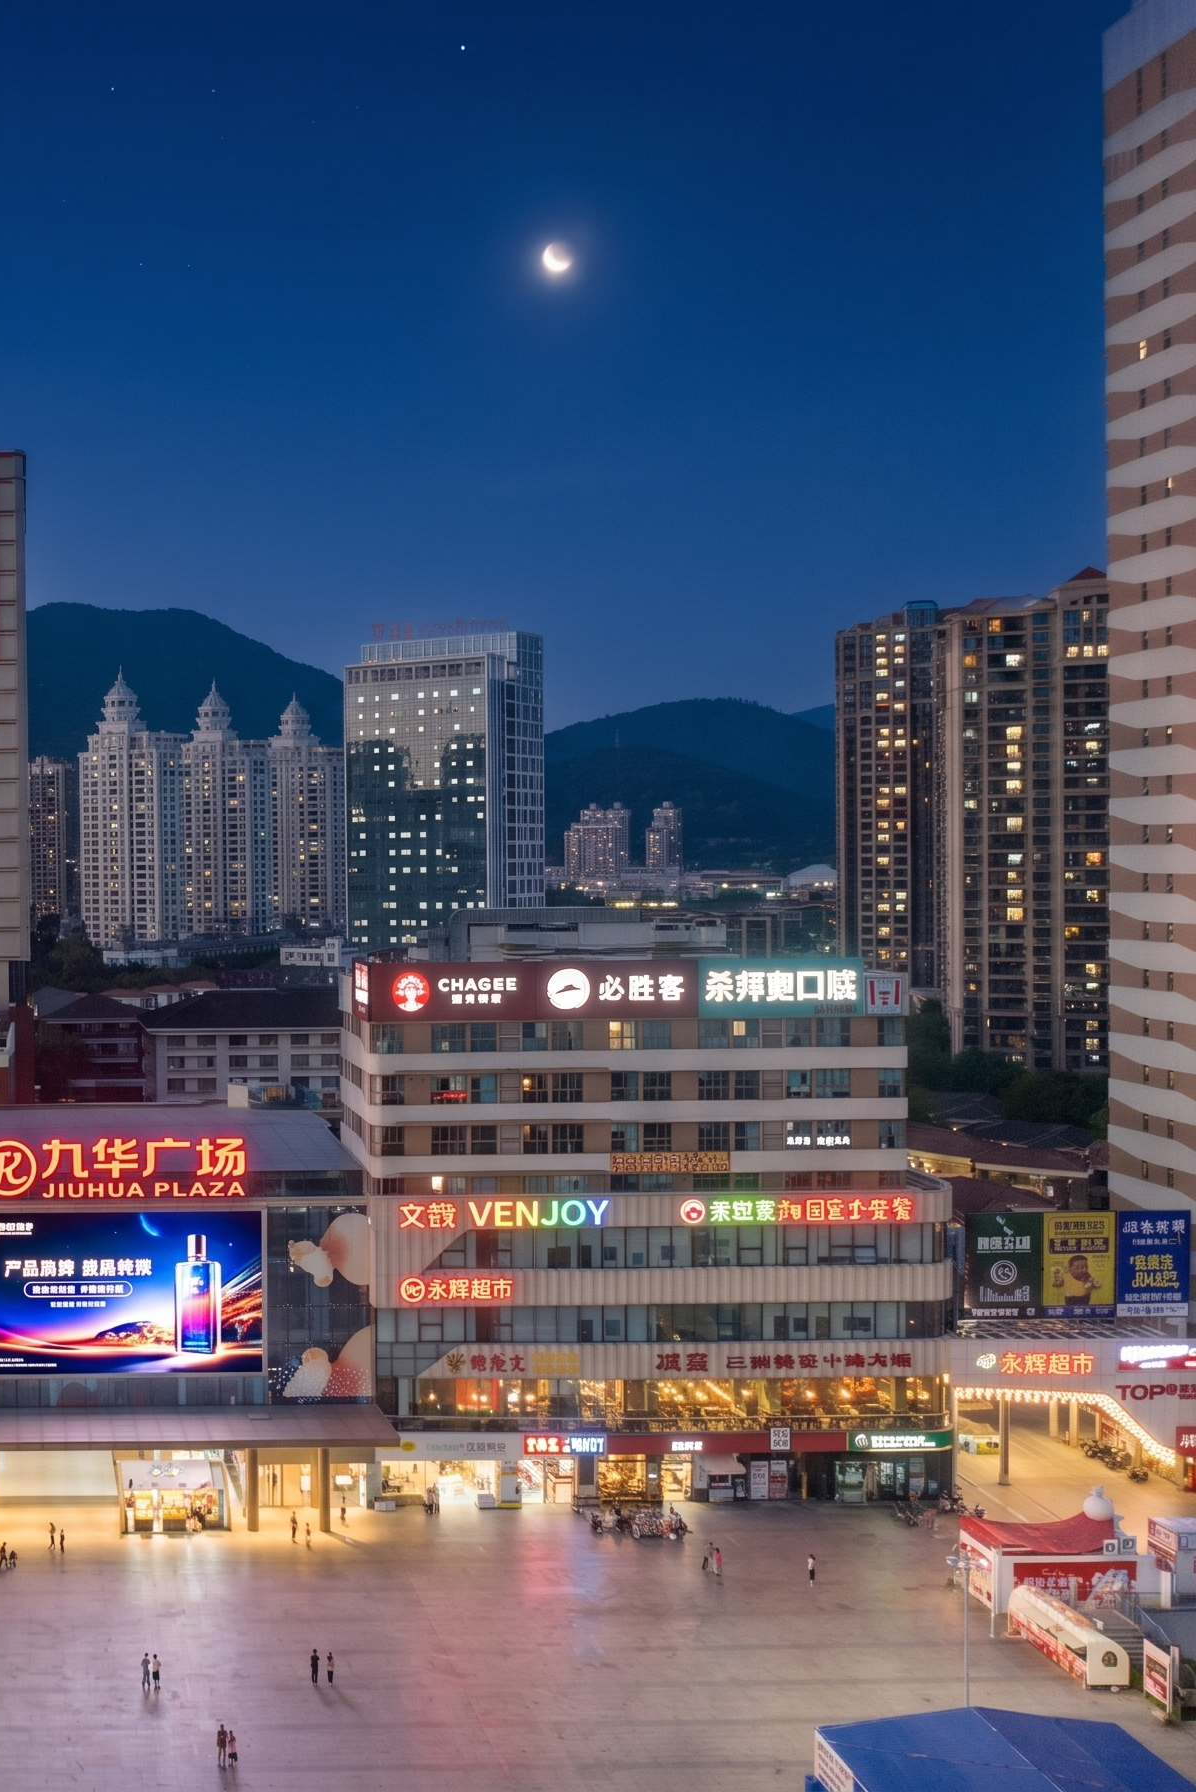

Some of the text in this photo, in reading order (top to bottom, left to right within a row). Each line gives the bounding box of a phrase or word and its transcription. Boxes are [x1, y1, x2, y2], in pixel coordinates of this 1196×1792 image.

[437, 977, 517, 992] CHAGEE
[599, 973, 685, 1002] 必胜客
[42, 1138, 246, 1179] 九华广场
[42, 1181, 246, 1199] JIUHUA PLAZA
[468, 1199, 610, 1228] VENJOY
[427, 1278, 513, 1300] 永辉超市
[1000, 1352, 1094, 1375] 永辉超市
[1115, 1384, 1166, 1401] TOP
